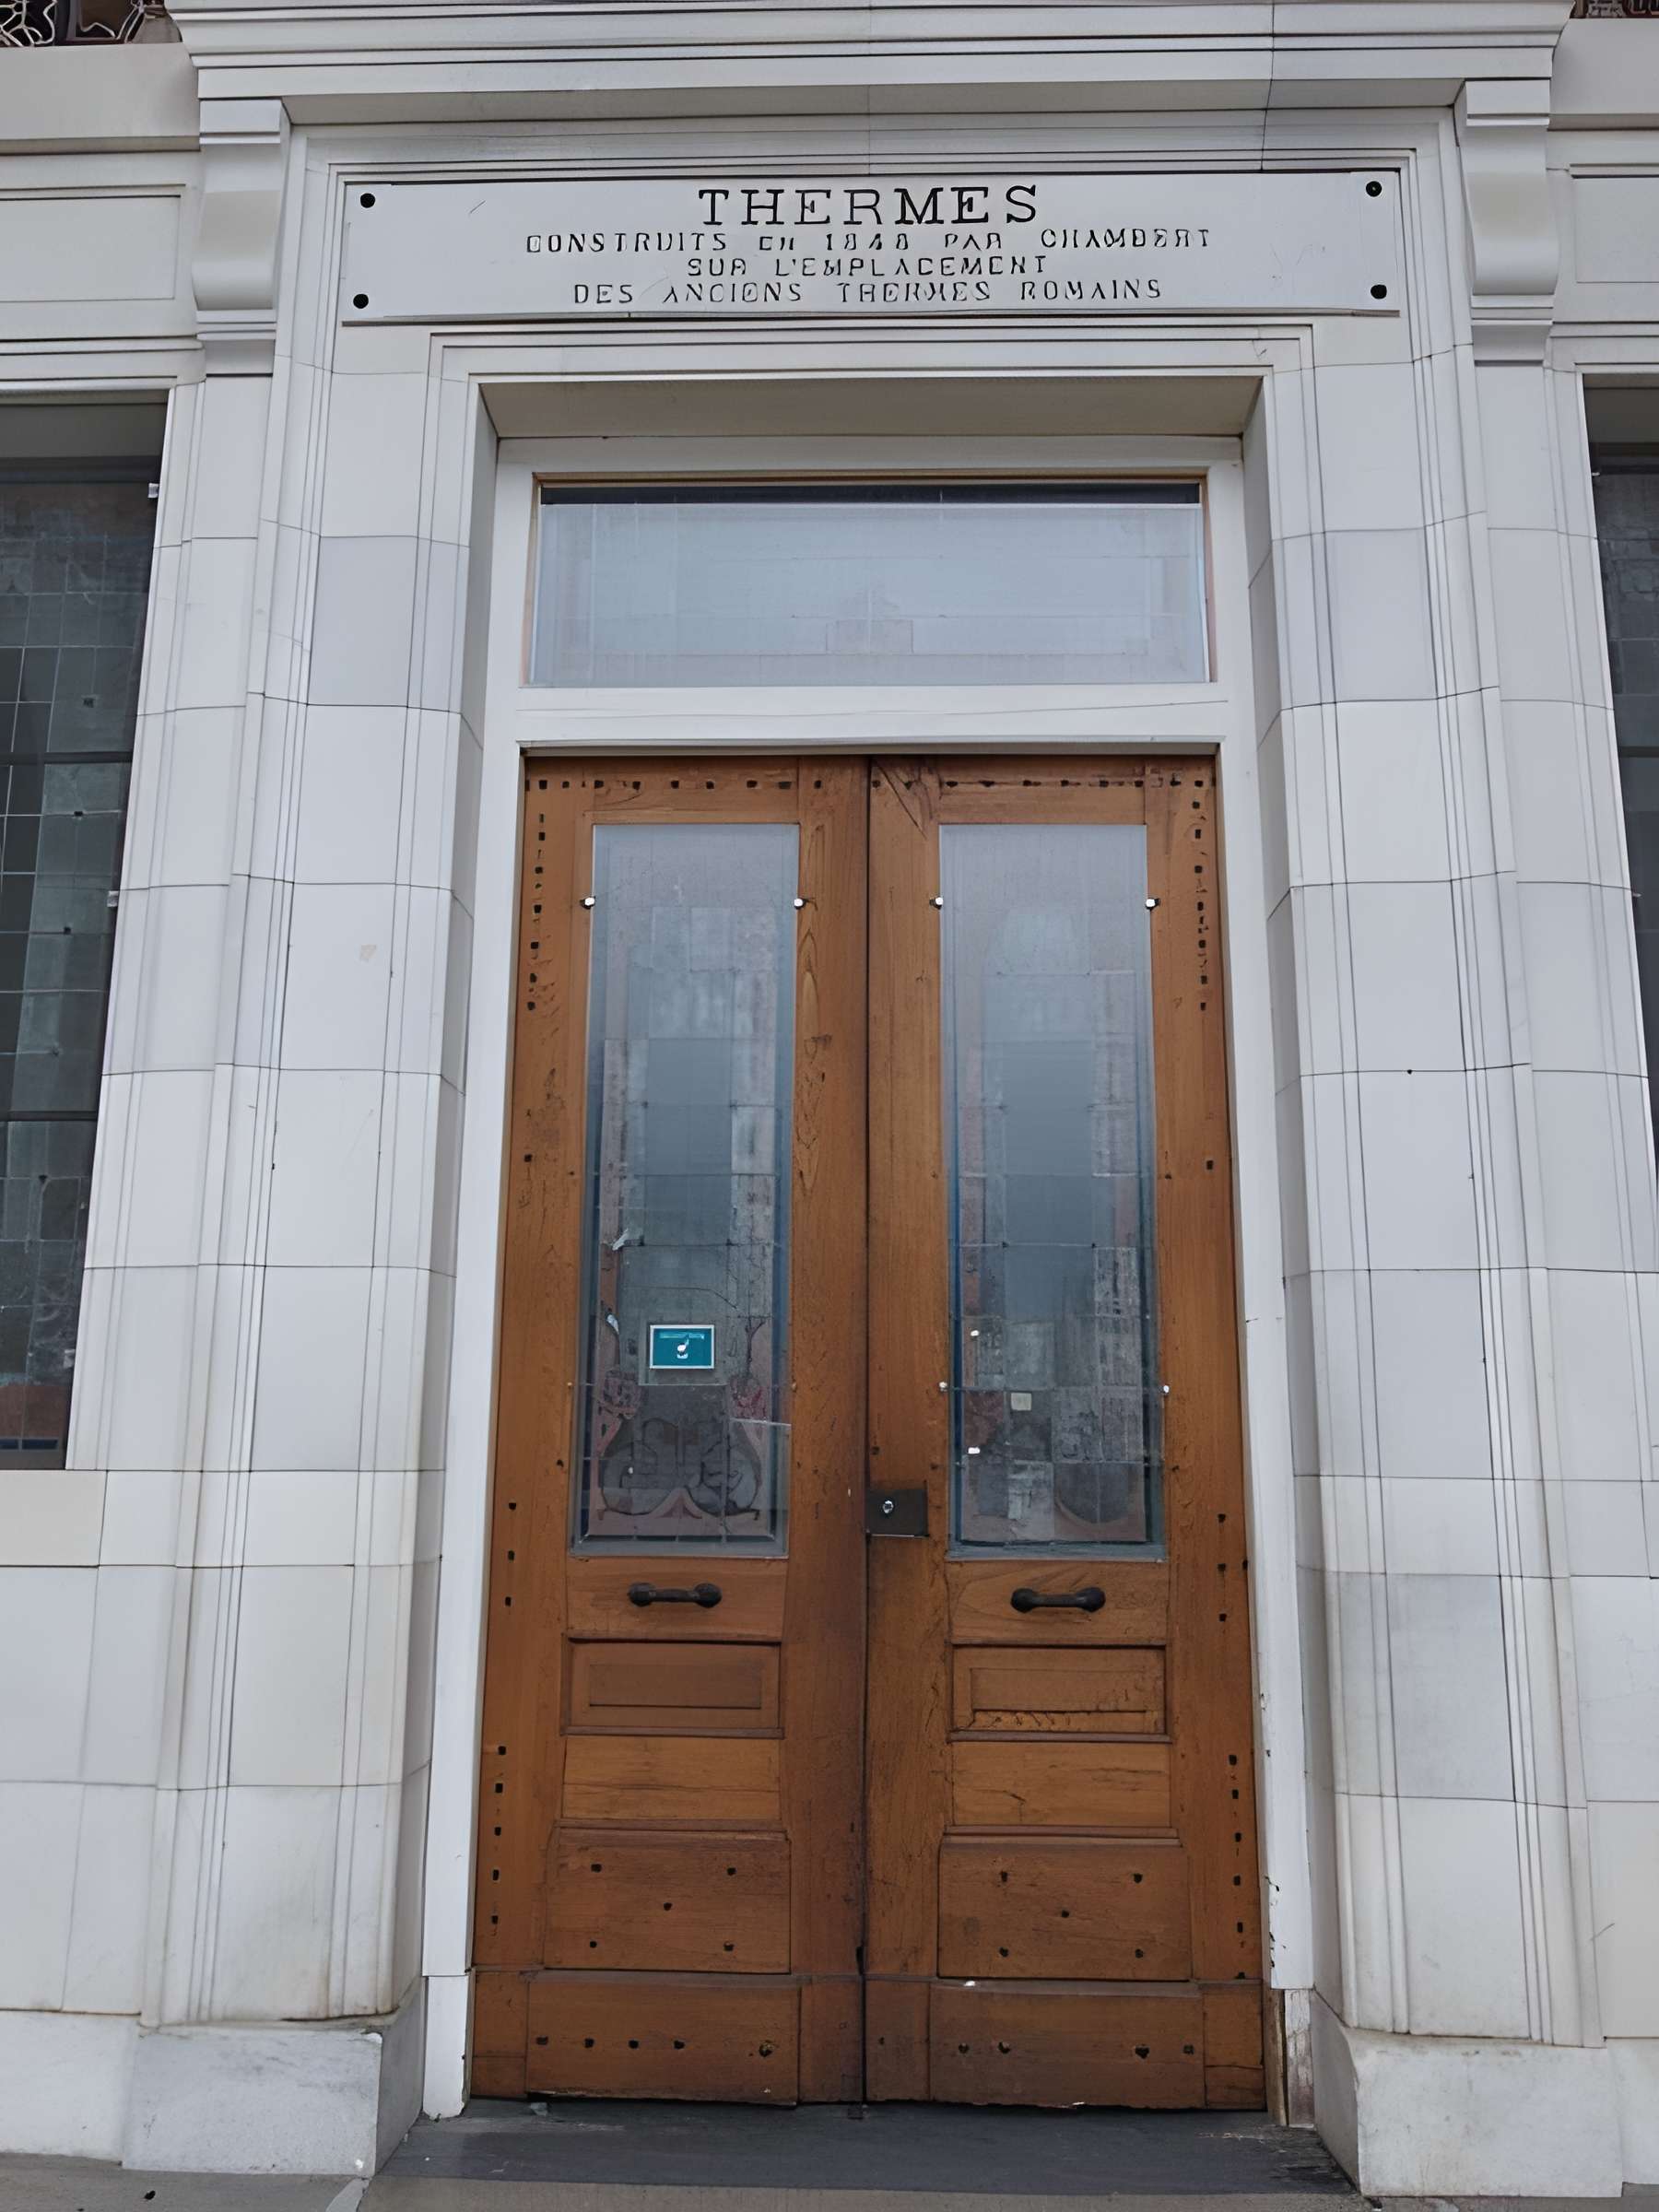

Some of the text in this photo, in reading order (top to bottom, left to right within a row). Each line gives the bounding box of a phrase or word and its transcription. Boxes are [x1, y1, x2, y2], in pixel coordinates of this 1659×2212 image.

[698, 184, 1038, 226] THERMES
[526, 231, 726, 253] CONSTRUITS
[944, 231, 1002, 252] PAR
[688, 257, 747, 277] SUR
[574, 284, 633, 304] DES
[1020, 278, 1161, 300] ROMAINS
